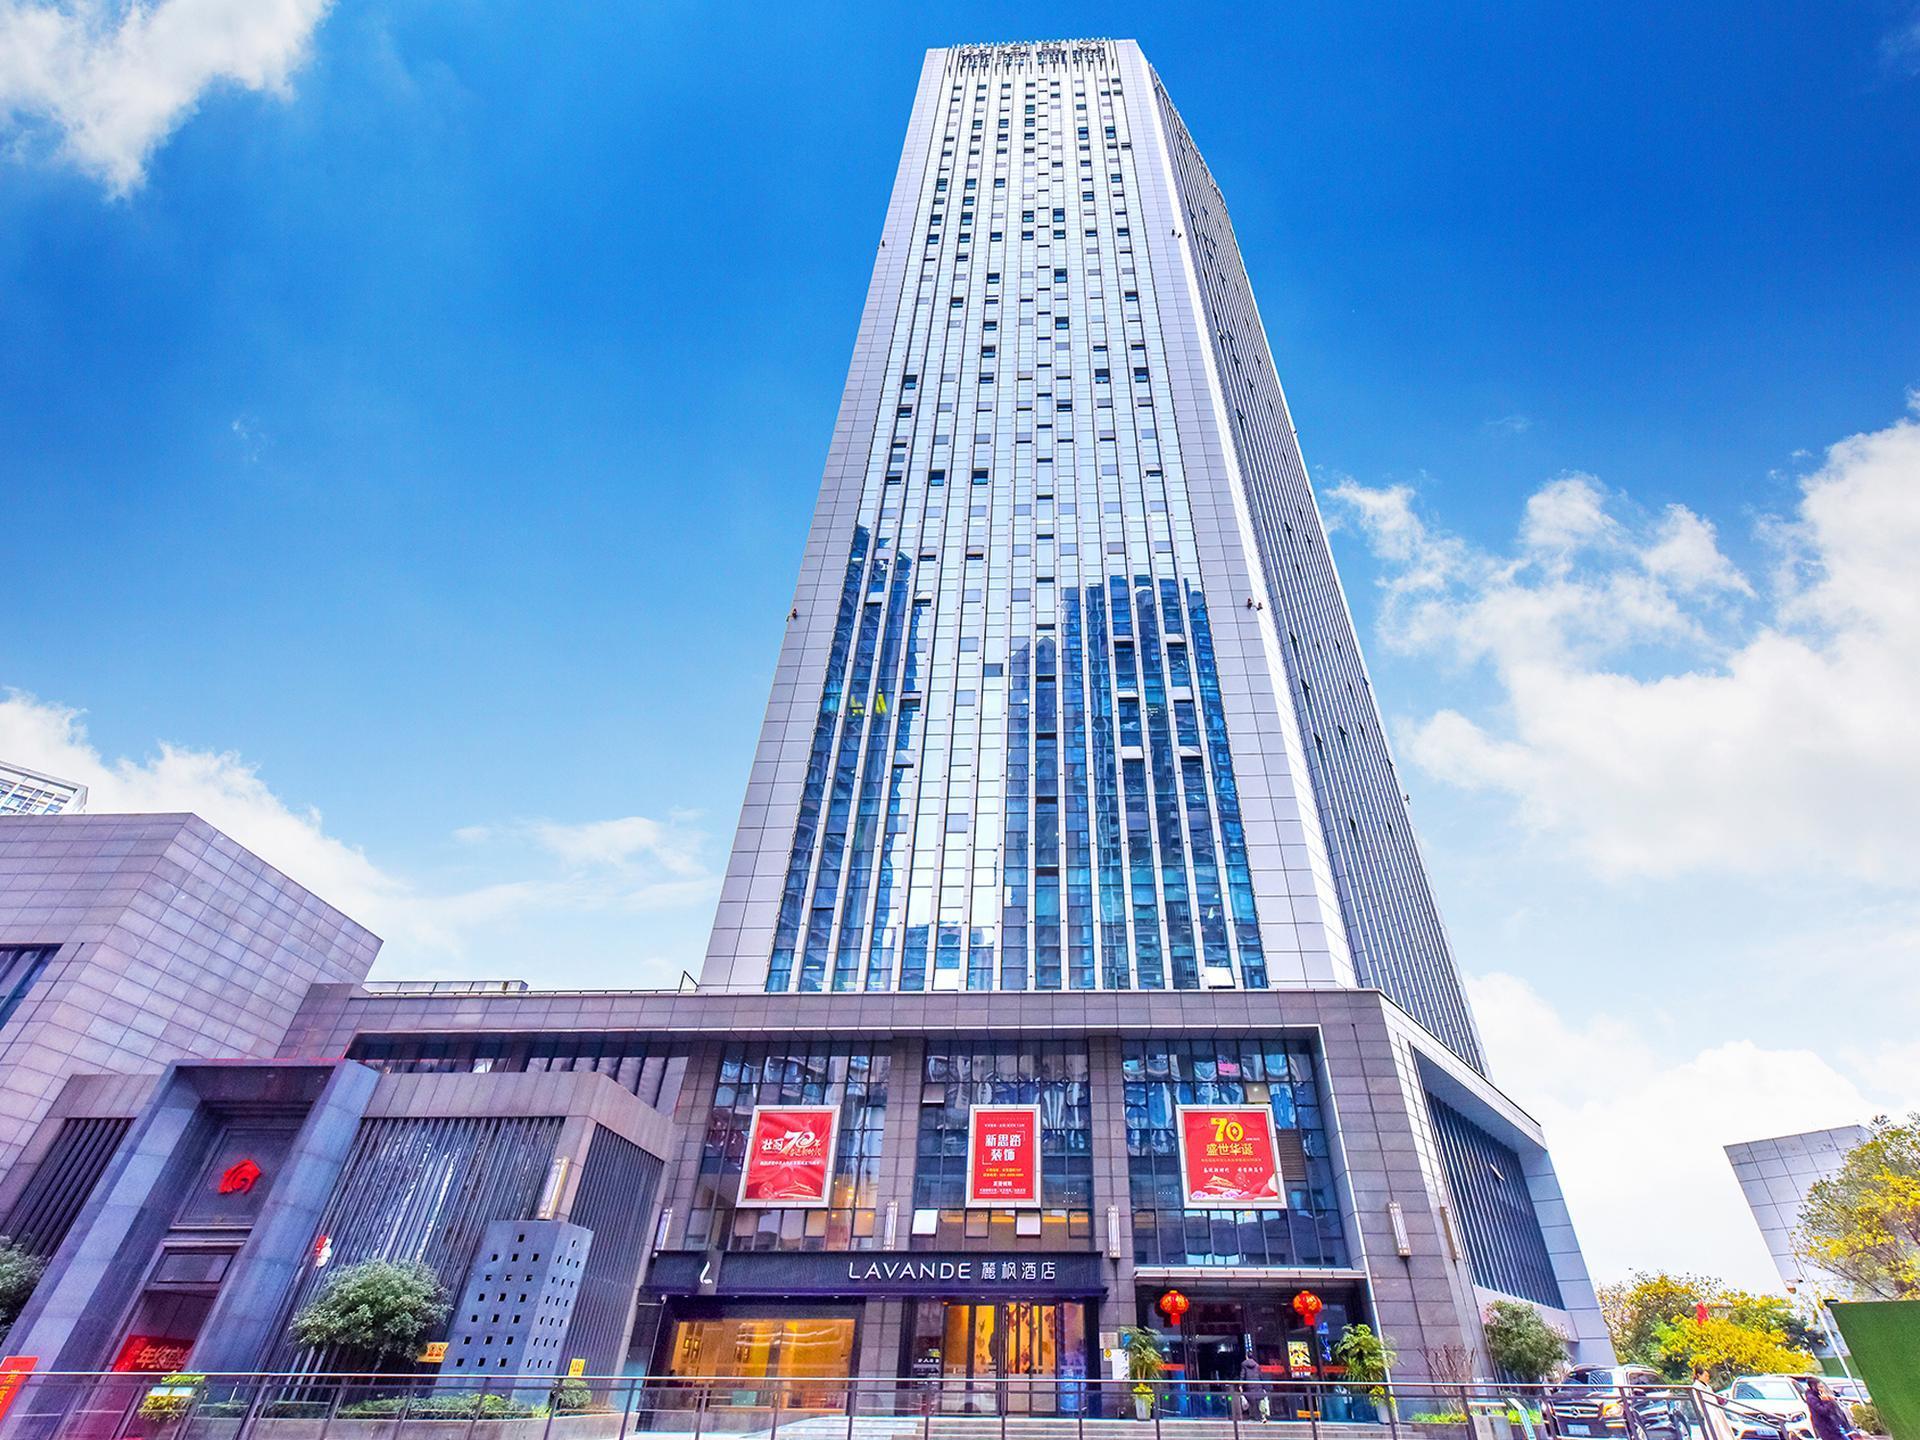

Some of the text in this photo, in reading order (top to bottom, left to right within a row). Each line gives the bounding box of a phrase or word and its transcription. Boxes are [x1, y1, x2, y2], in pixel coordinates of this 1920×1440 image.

[1210, 1117, 1244, 1142] 70
[985, 1133, 1022, 1147] 新思路
[990, 1149, 1016, 1161] 装饰
[1206, 1143, 1254, 1156] 盛世华诞
[848, 1262, 972, 1279] LAVANDE
